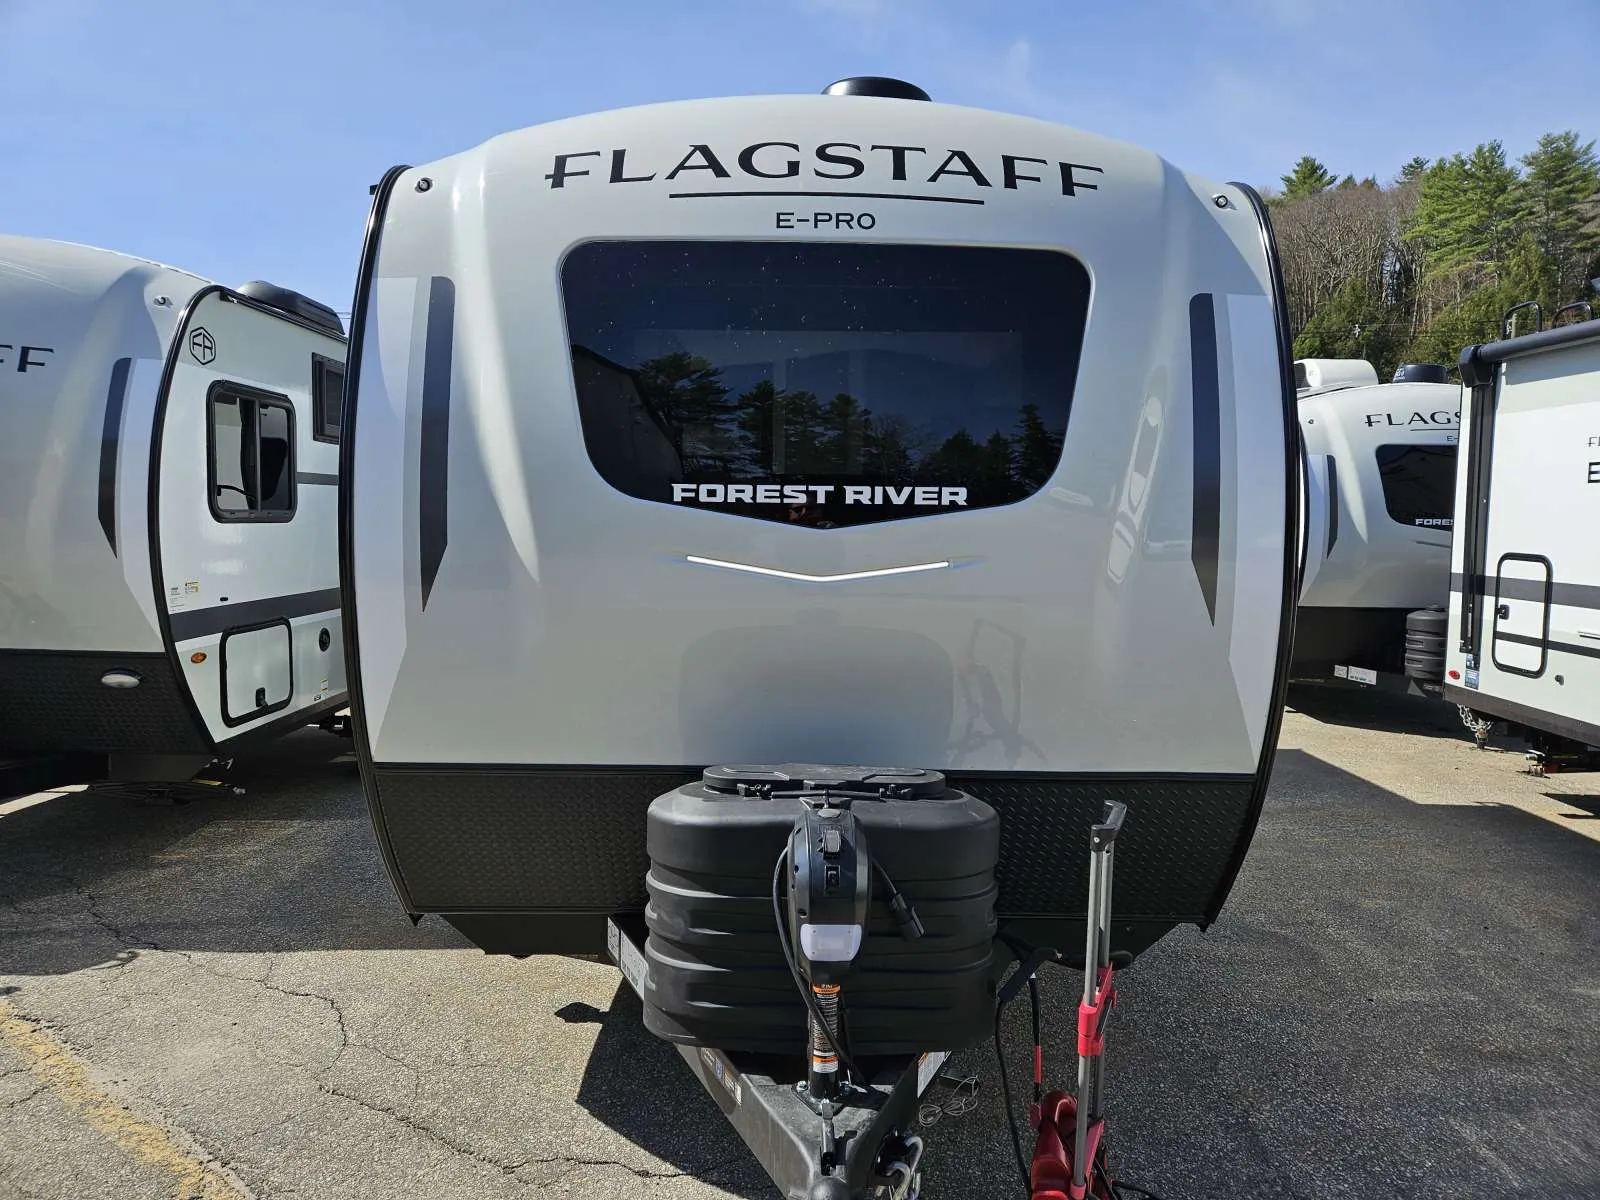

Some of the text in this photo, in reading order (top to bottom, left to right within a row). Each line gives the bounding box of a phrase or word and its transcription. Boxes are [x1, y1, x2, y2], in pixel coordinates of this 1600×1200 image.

[545, 141, 1105, 197] FLAGSTAFF
[776, 211, 876, 230] E-PRO
[671, 483, 968, 506] FOREST RIVER
